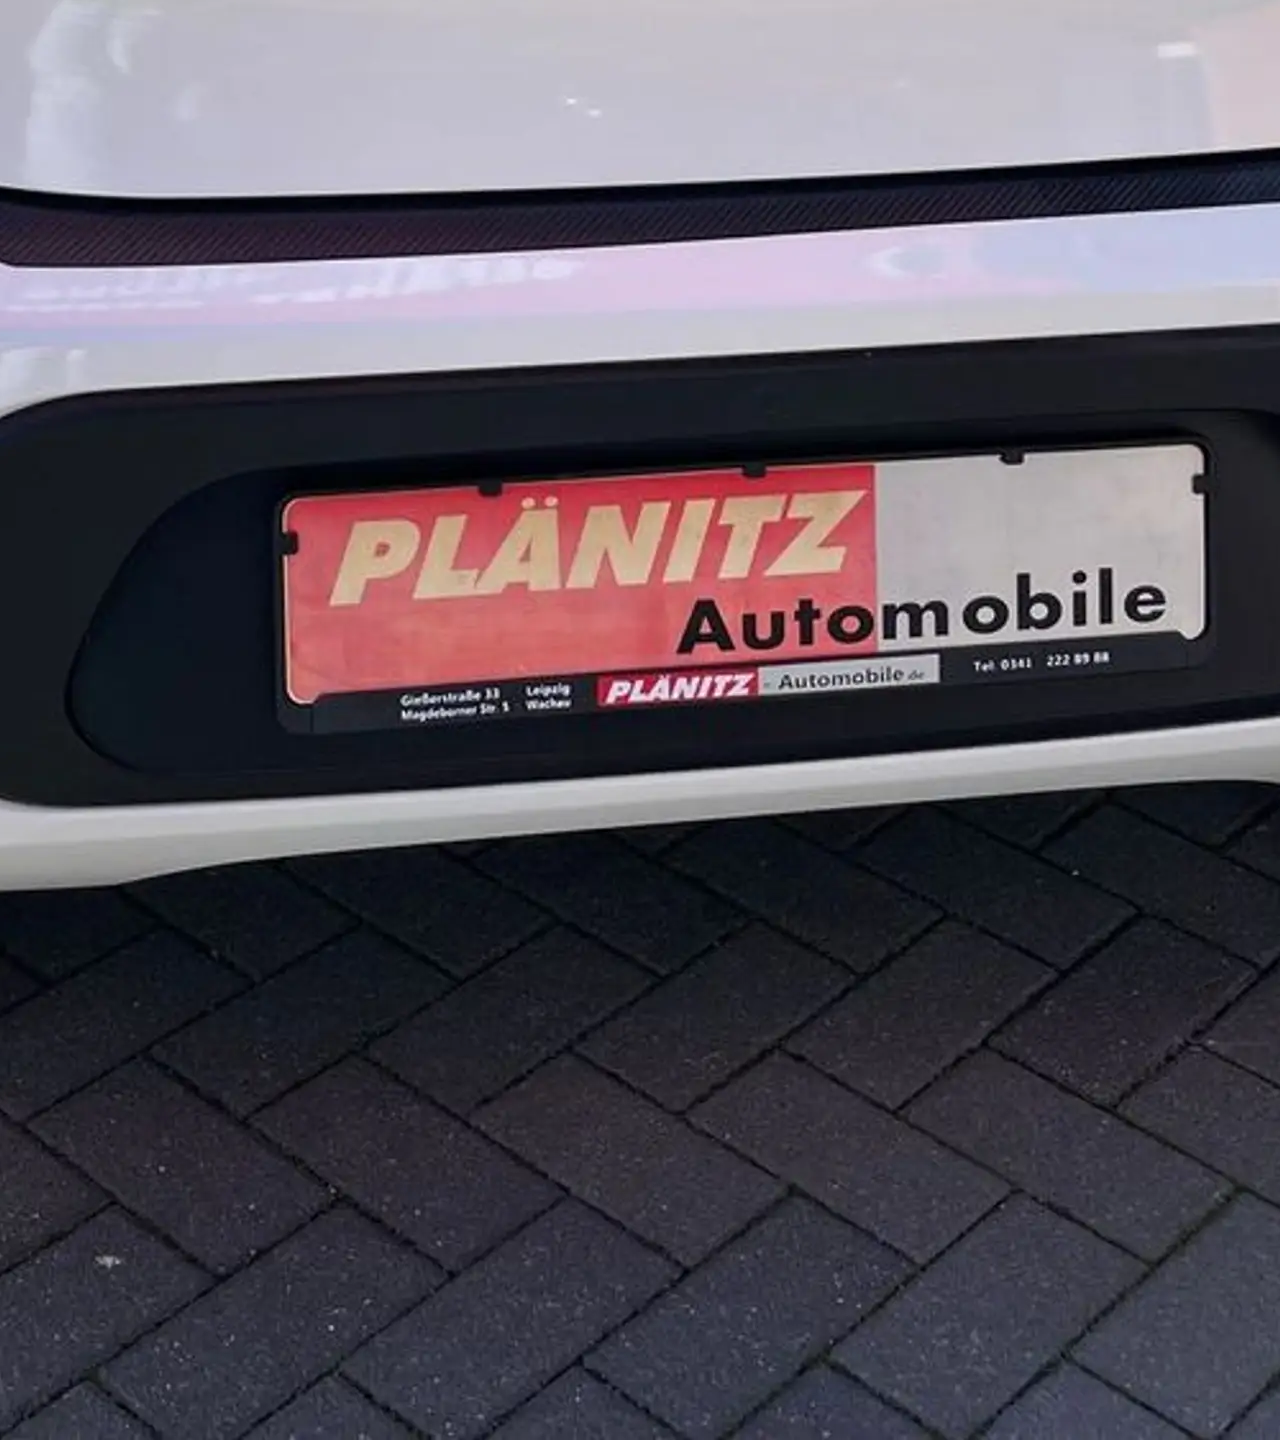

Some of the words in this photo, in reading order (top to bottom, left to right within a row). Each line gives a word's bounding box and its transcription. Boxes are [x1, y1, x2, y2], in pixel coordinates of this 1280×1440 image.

[329, 488, 868, 608] PLÄNITZ
[676, 566, 1167, 657] Automobile
[1046, 654, 1070, 667] 222
[525, 683, 570, 698] Leipzig
[604, 670, 755, 705] PLÄNITZ
